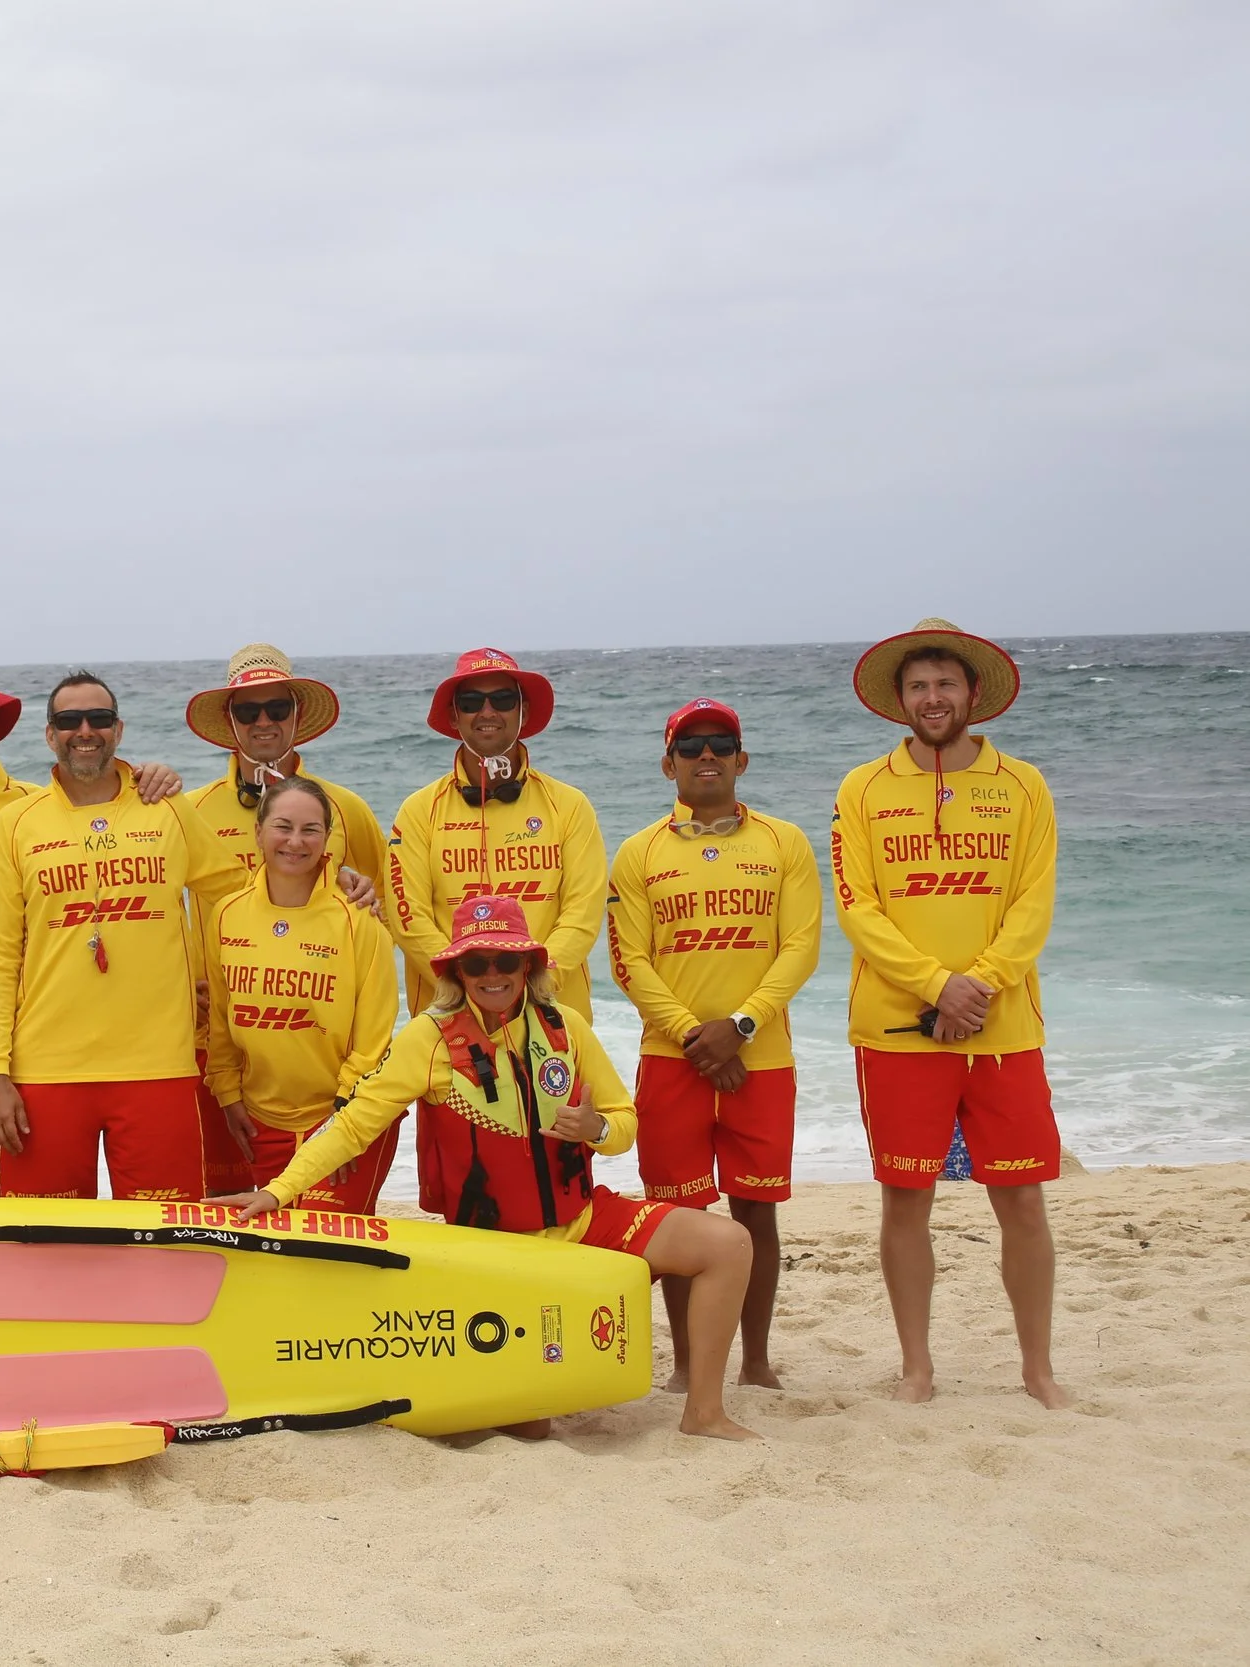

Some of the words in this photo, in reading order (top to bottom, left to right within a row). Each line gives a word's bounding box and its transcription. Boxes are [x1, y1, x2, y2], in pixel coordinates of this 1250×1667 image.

[249, 671, 268, 679] SURF
[471, 660, 492, 672] SURF
[970, 787, 1010, 802] RICH
[877, 807, 917, 820] DHL
[970, 806, 1012, 814] ISUZU
[125, 830, 163, 838] ISUZU
[443, 821, 485, 831] DHL
[31, 840, 71, 855] DHL
[83, 833, 118, 853] KAB
[504, 831, 539, 845] ZANE
[883, 834, 933, 864] SURF
[938, 832, 1012, 861] RESCUE
[442, 848, 488, 874] SURF
[494, 844, 562, 873] RESCUE
[736, 863, 777, 873] ISUZU
[37, 862, 89, 897] SURF
[95, 856, 167, 888] RESCUE
[645, 869, 681, 888] DHL
[830, 831, 856, 912] AMPOL
[388, 852, 414, 932] AMPOL
[461, 881, 546, 905] DHL
[905, 871, 994, 897] DHL
[61, 896, 152, 928] DHL
[653, 891, 699, 926] SURF
[704, 888, 776, 917] RESCUE
[461, 923, 479, 937] SURF
[479, 921, 510, 933] RESCUE
[220, 936, 251, 948] DHL
[299, 942, 339, 955] ISUZU
[672, 926, 757, 954] DHL
[306, 951, 330, 959] UTE
[607, 911, 633, 994] AMPOL
[262, 967, 337, 1003] RESCUE
[233, 1004, 316, 1031] DHL
[529, 1040, 548, 1060] 18
[543, 1058, 562, 1068] SURF
[539, 1079, 555, 1096] LIFE
[555, 1074, 571, 1097] SAVING
[892, 1155, 918, 1172] SURF
[919, 1158, 944, 1173] RESC
[993, 1157, 1038, 1171] DHL
[654, 1185, 679, 1199] SURF
[681, 1173, 714, 1197] RESCUE
[742, 1174, 786, 1188] DHL
[134, 1188, 184, 1200] DHL
[161, 1203, 292, 1232] RESCUE
[622, 1202, 659, 1243] DHL
[301, 1217, 390, 1242] SURF
[371, 1309, 455, 1332] BANK
[275, 1335, 456, 1362] MACQUARIE
[177, 1426, 243, 1440] KRACKA
